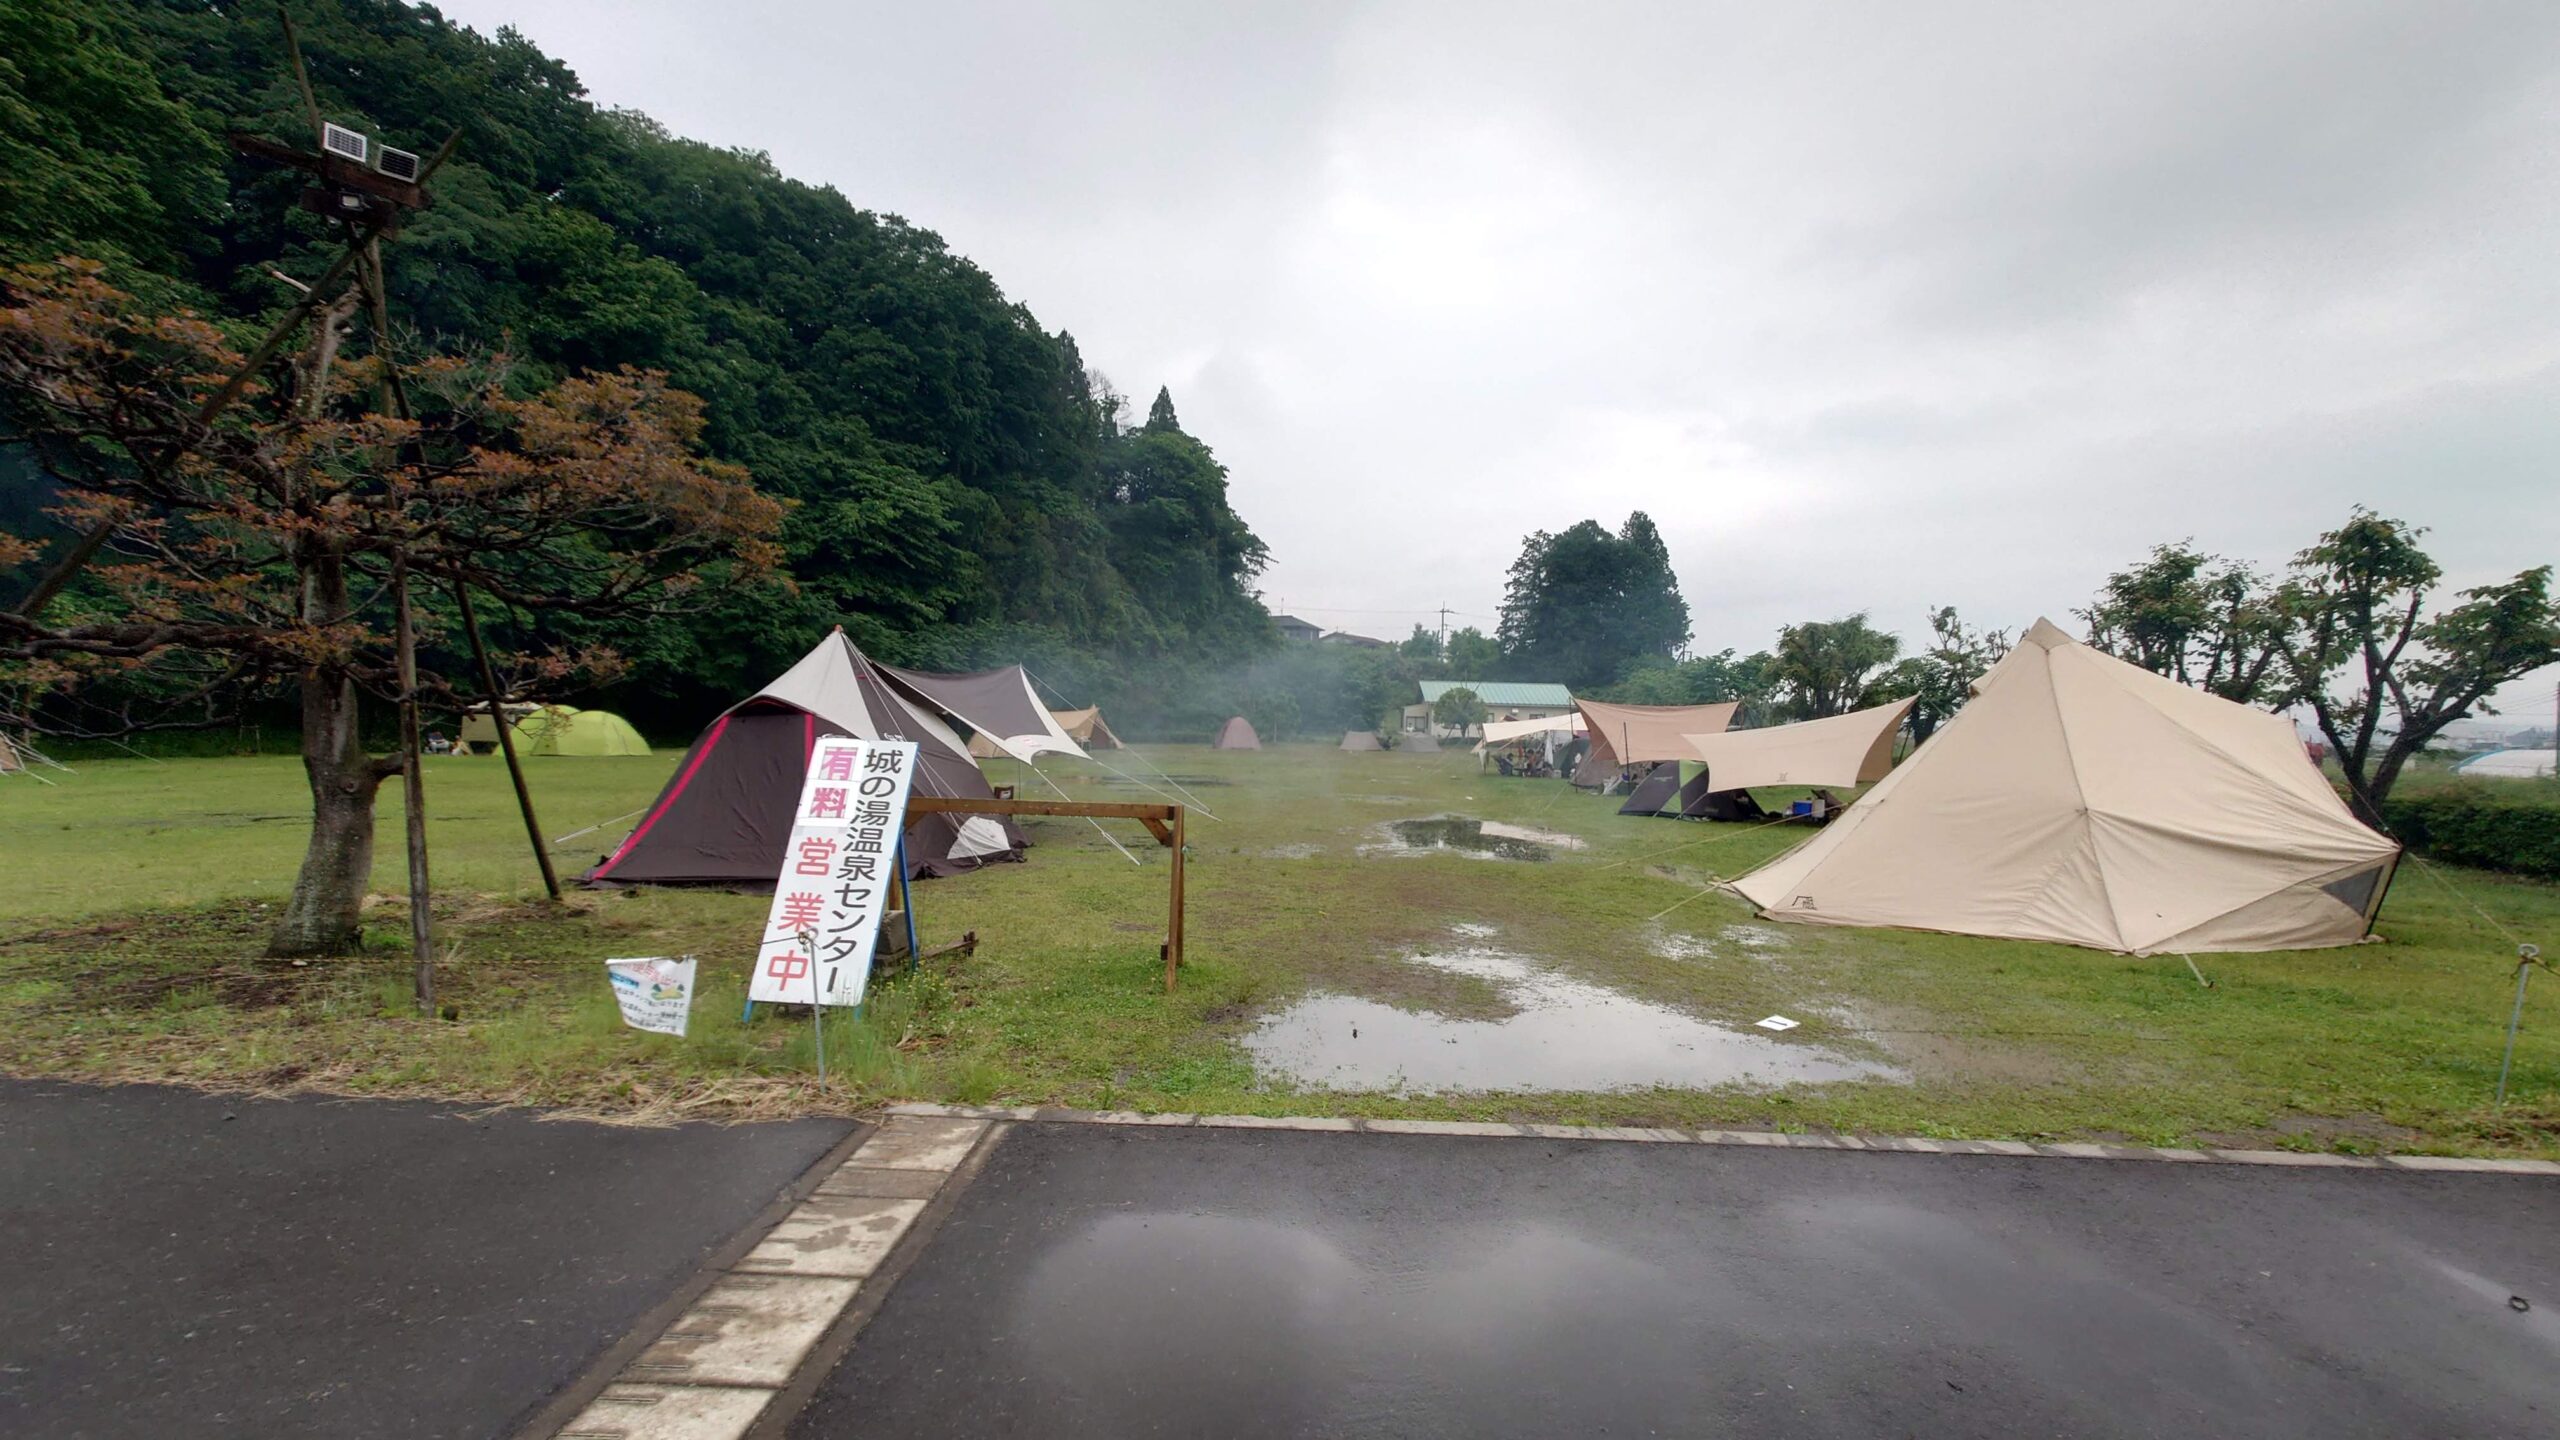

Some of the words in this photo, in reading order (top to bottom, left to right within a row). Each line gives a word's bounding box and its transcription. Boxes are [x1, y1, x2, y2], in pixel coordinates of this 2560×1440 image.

[823, 749, 903, 992] 城の湯温泉センター
